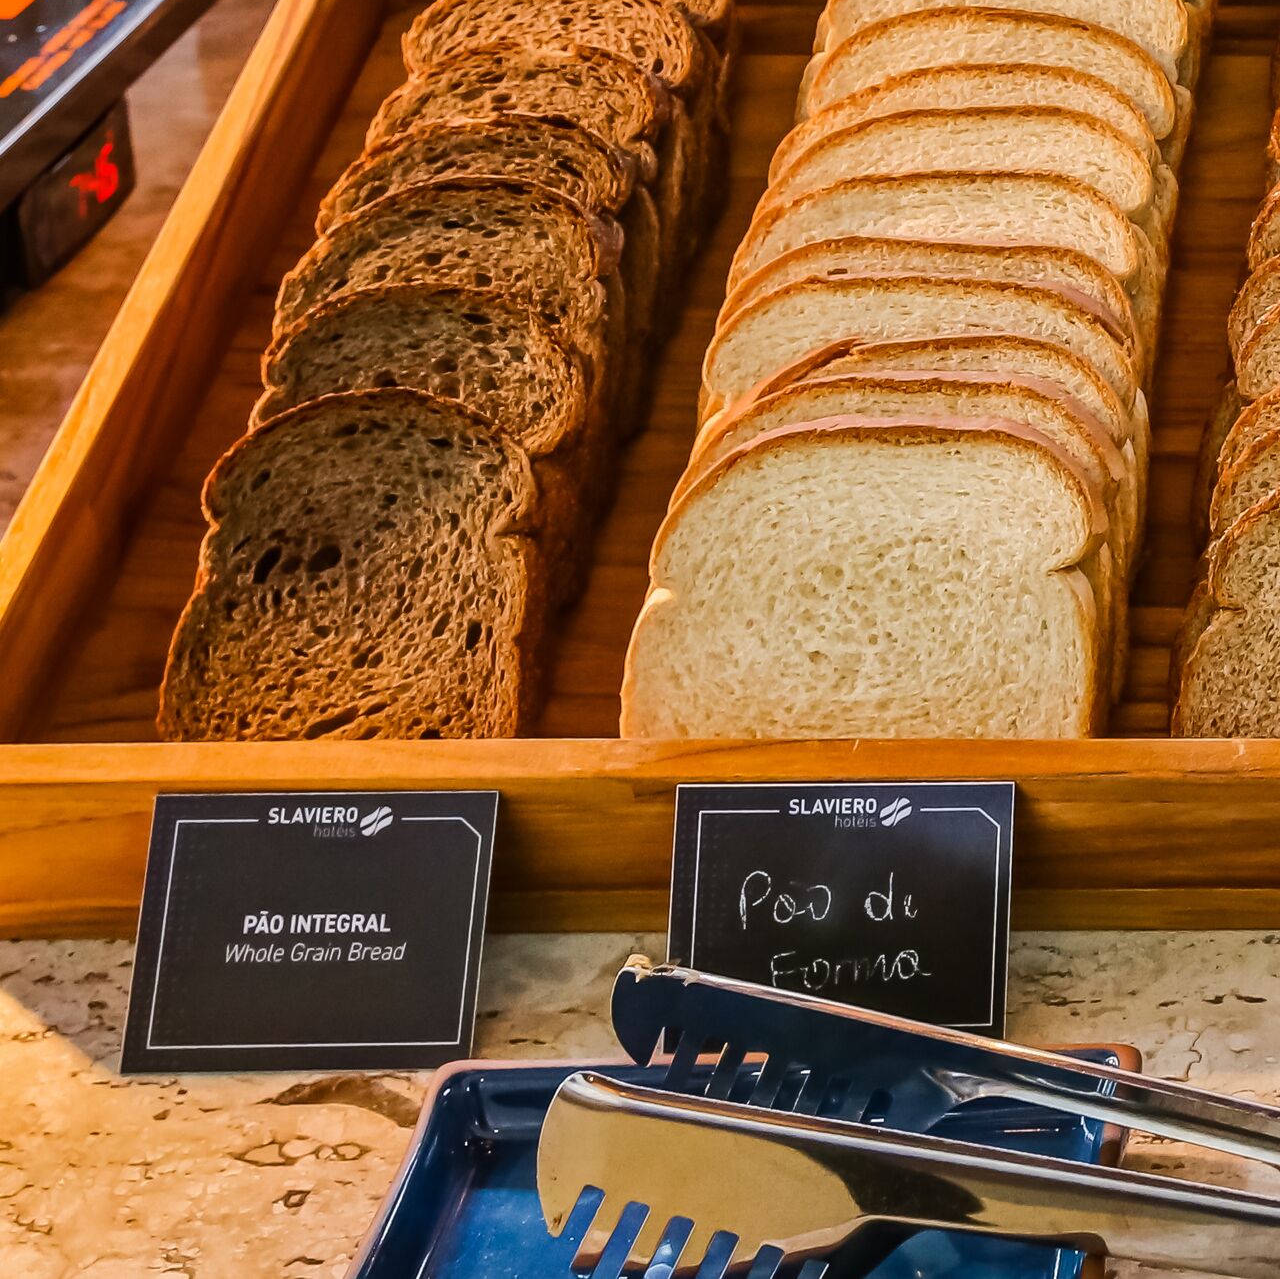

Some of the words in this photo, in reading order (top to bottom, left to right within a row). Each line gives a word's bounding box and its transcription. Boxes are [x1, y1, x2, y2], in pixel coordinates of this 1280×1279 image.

[267, 806, 358, 825] SLAVIERO
[788, 797, 878, 816] SLAVIERO
[242, 910, 284, 935] PÃO
[289, 913, 391, 934] INTEGRAL
[225, 943, 285, 963] Whole
[290, 942, 342, 963] Grain
[347, 941, 407, 962] Bread
[769, 949, 932, 990] Forma
